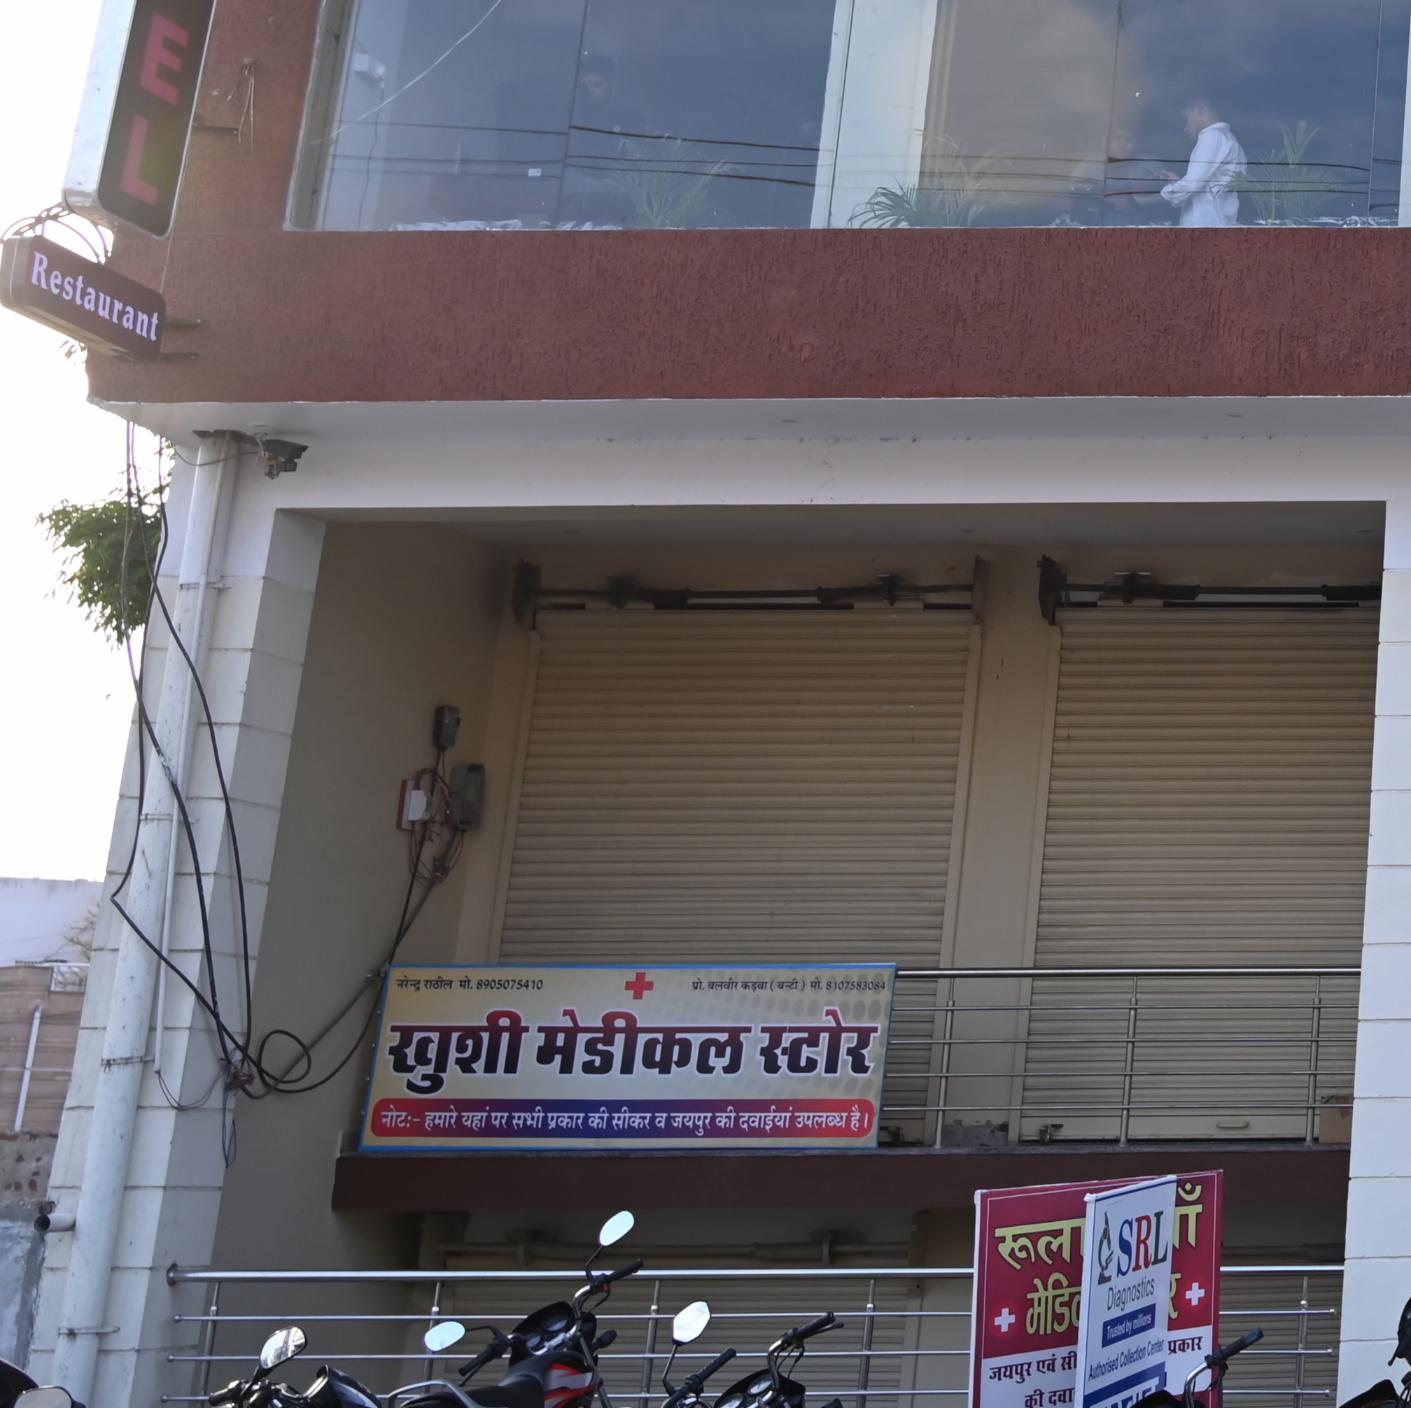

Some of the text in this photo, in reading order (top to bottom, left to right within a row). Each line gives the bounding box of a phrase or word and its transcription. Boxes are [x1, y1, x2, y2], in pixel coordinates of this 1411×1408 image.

[31, 248, 159, 342] Restaurant
[476, 979, 544, 990] 8905075410
[826, 980, 886, 991] 8107583084
[387, 1008, 881, 1094] खुशी मेडीकल स्टोर
[424, 1105, 459, 1130] हमारे
[461, 1107, 489, 1130] यहां
[490, 1110, 508, 1130] पर
[511, 1106, 544, 1130] सभी
[547, 1110, 583, 1130] प्रकार
[588, 1107, 608, 1130] की
[611, 1107, 651, 1130] सीकर
[654, 1112, 667, 1130] व
[670, 1111, 712, 1136] जयपुर
[715, 1107, 736, 1130] की
[738, 1106, 793, 1129] दवाईयां
[794, 1110, 847, 1130] उपलब्ध
[1116, 1210, 1168, 1277] SRL
[1106, 1277, 1156, 1311] Diagnostics
[1106, 1320, 1126, 1340] Trusted
[1126, 1319, 1133, 1335] by
[989, 1361, 1032, 1384] जयपुर
[1036, 1352, 1056, 1375] एवं
[1088, 1352, 1119, 1382] Authorised
[1119, 1344, 1146, 1368] Collection
